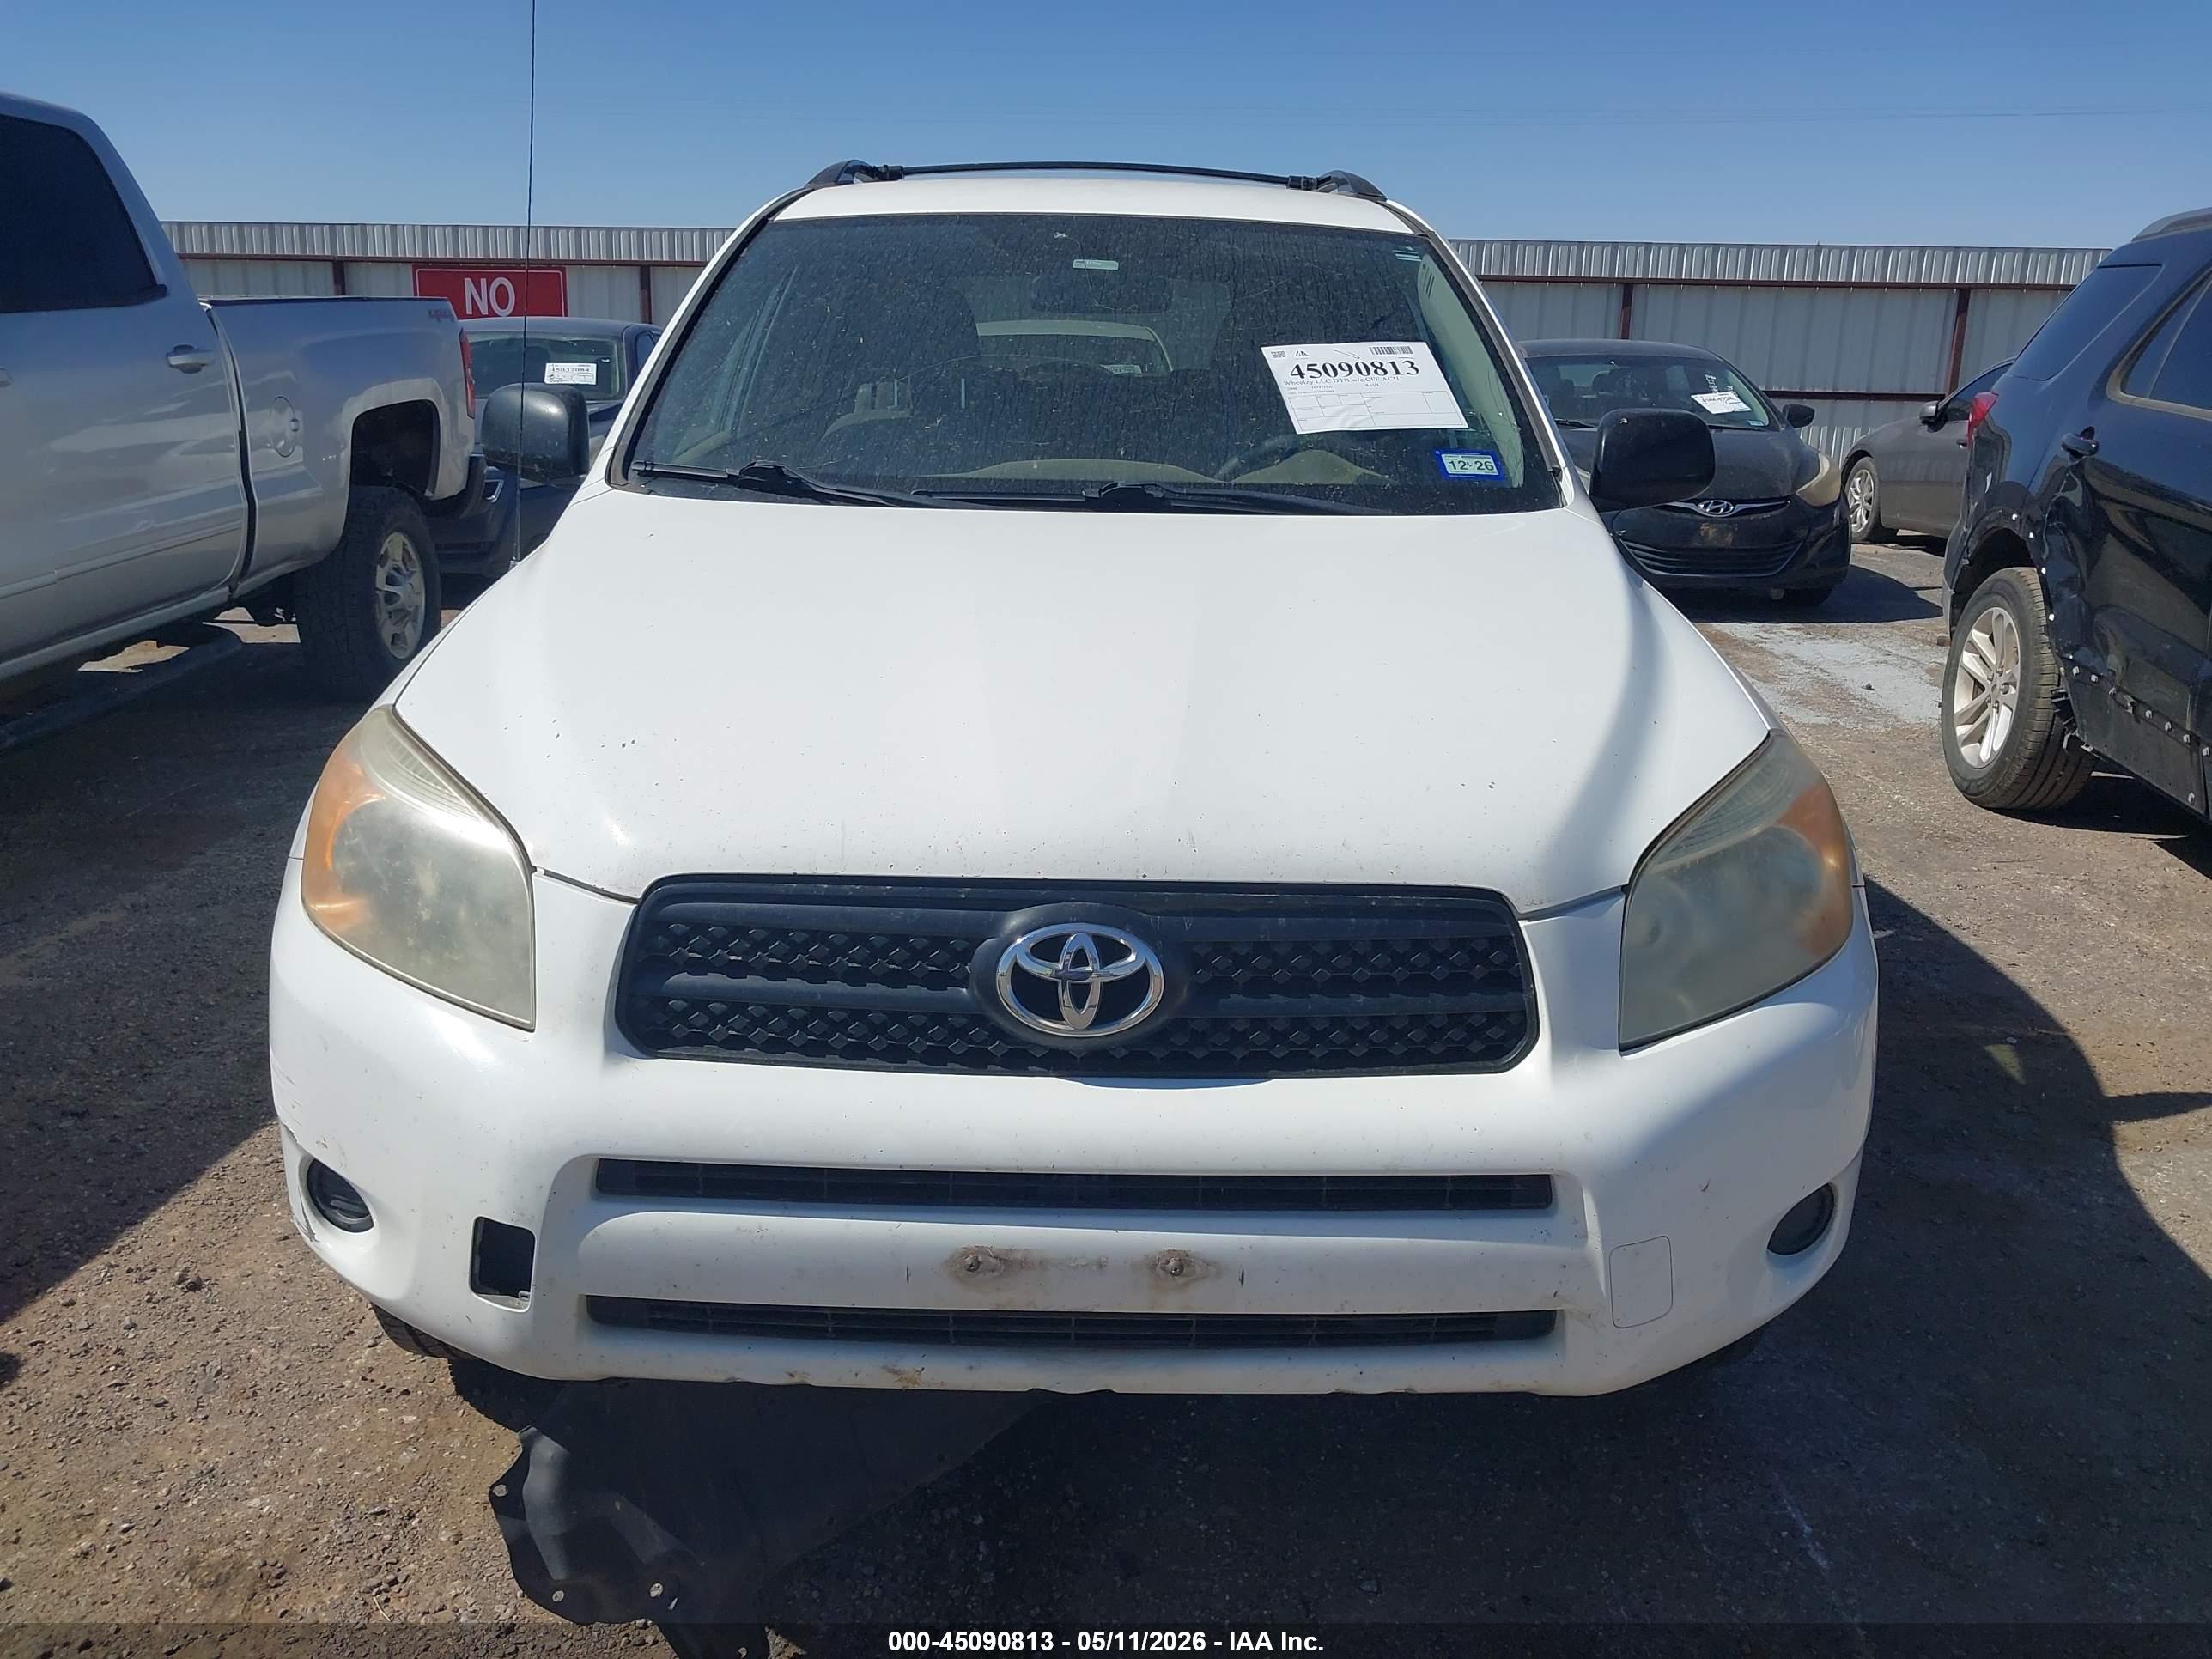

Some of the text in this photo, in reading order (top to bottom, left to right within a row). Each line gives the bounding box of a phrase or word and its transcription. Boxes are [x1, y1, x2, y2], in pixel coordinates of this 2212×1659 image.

[464, 276, 516, 317] NO
[1290, 360, 1419, 380] 45090813
[1449, 460, 1494, 471] 12 26
